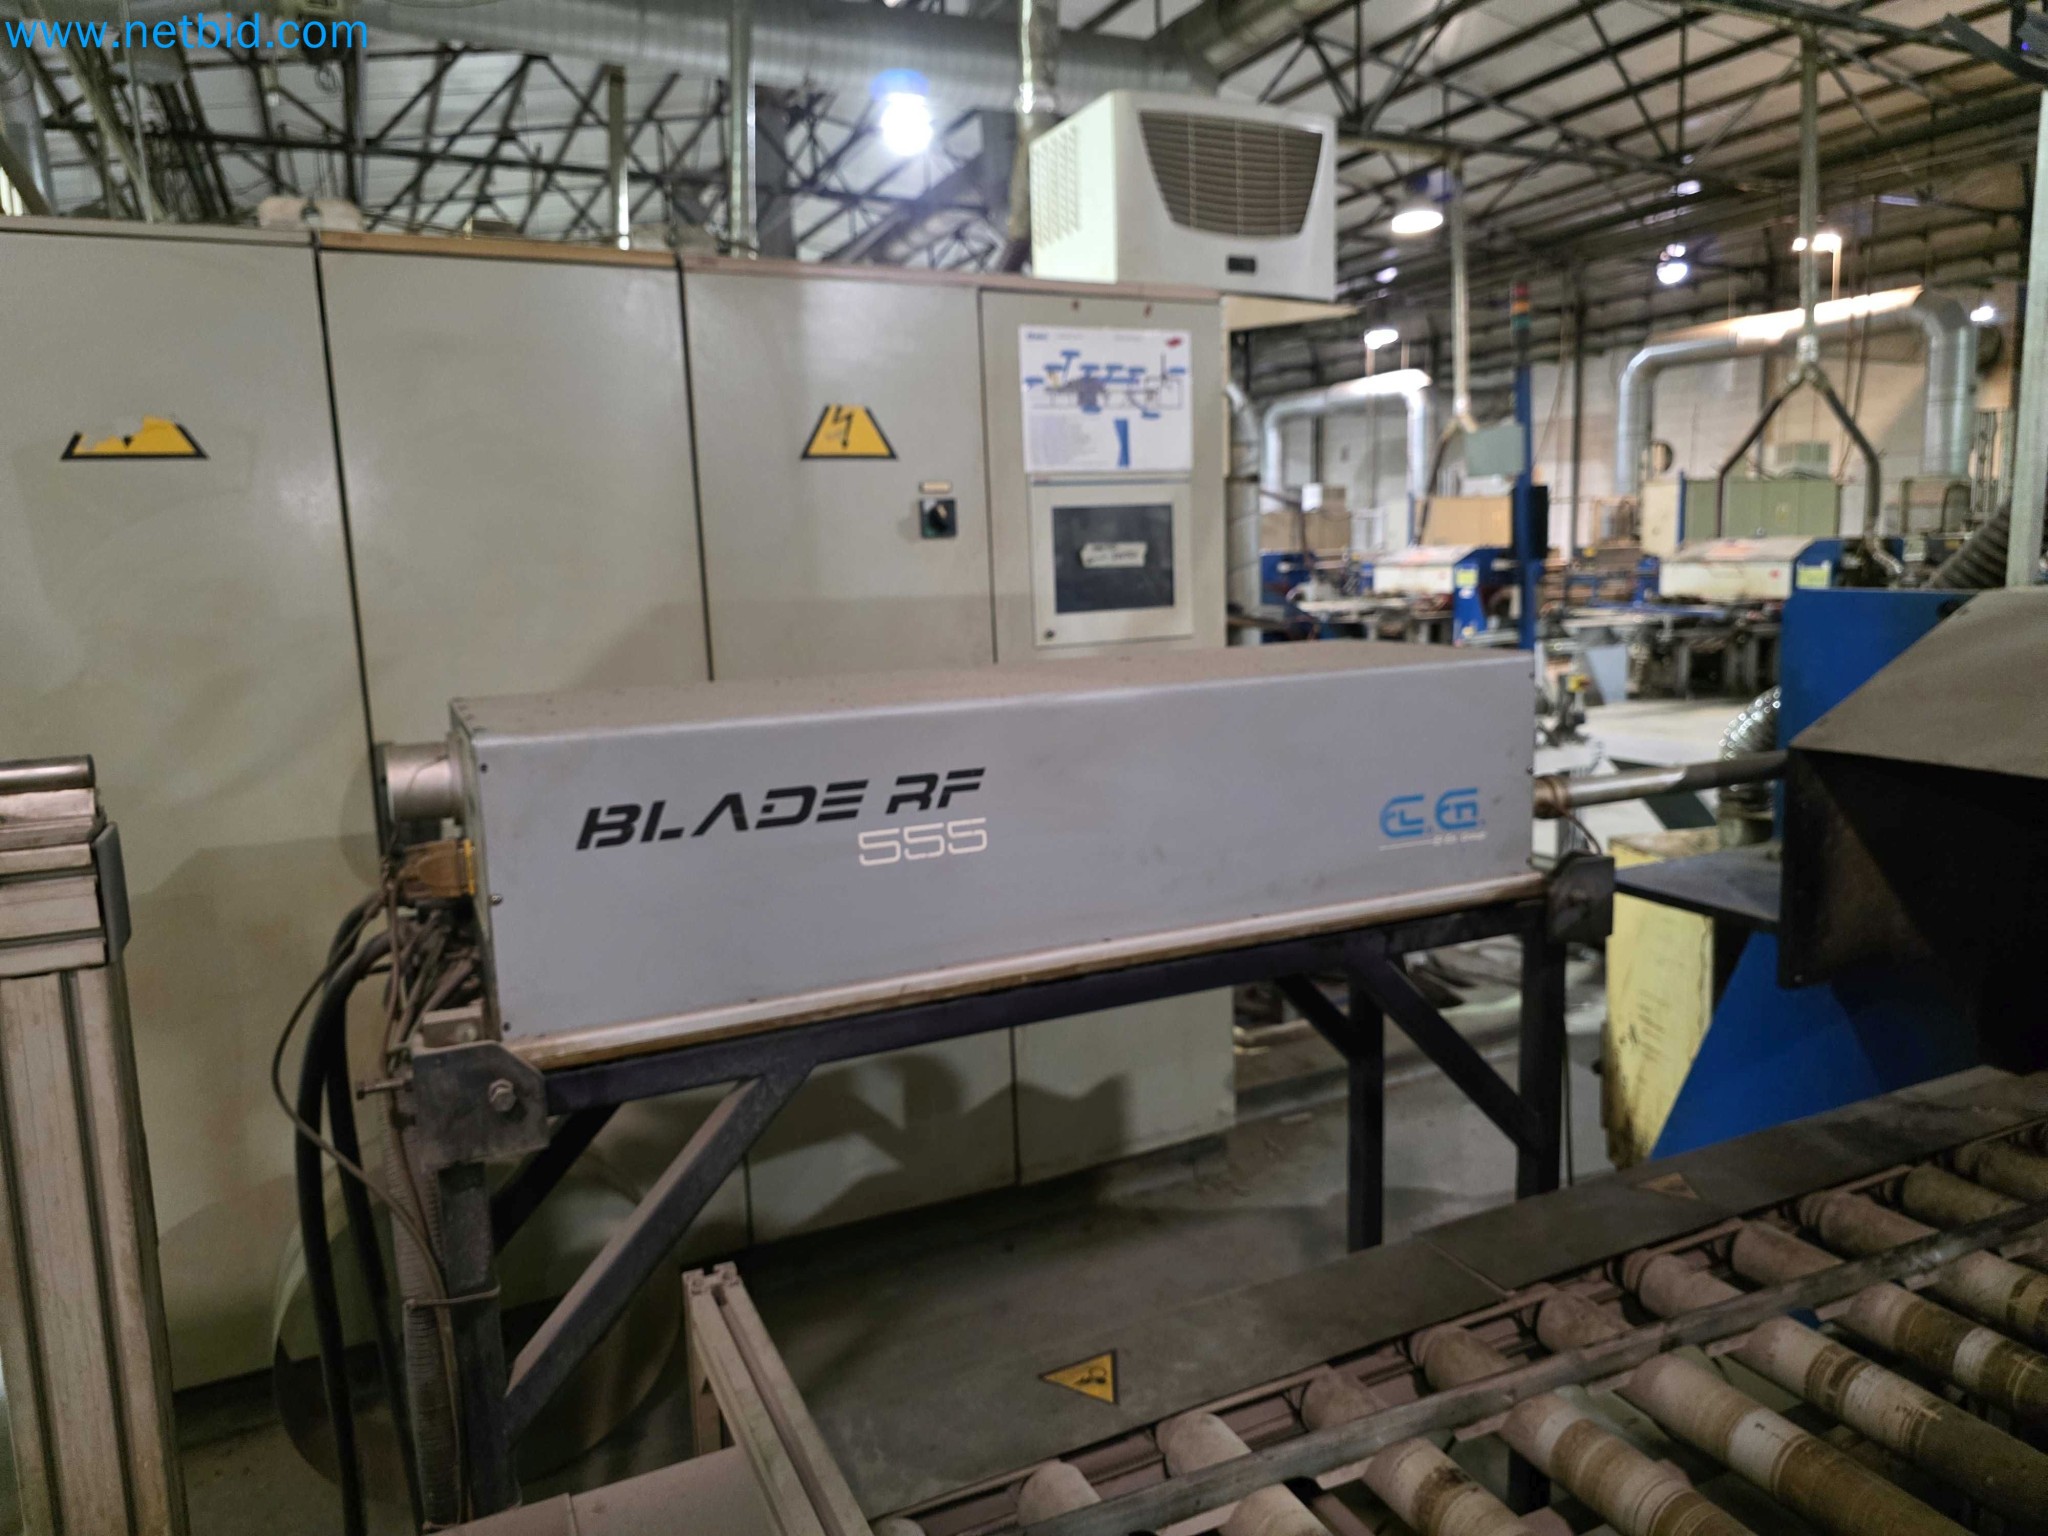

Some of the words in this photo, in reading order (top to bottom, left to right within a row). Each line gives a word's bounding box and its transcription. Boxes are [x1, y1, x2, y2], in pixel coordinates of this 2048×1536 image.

[576, 779, 869, 850] BLADE
[885, 767, 986, 815] RF
[858, 817, 988, 866] 555
